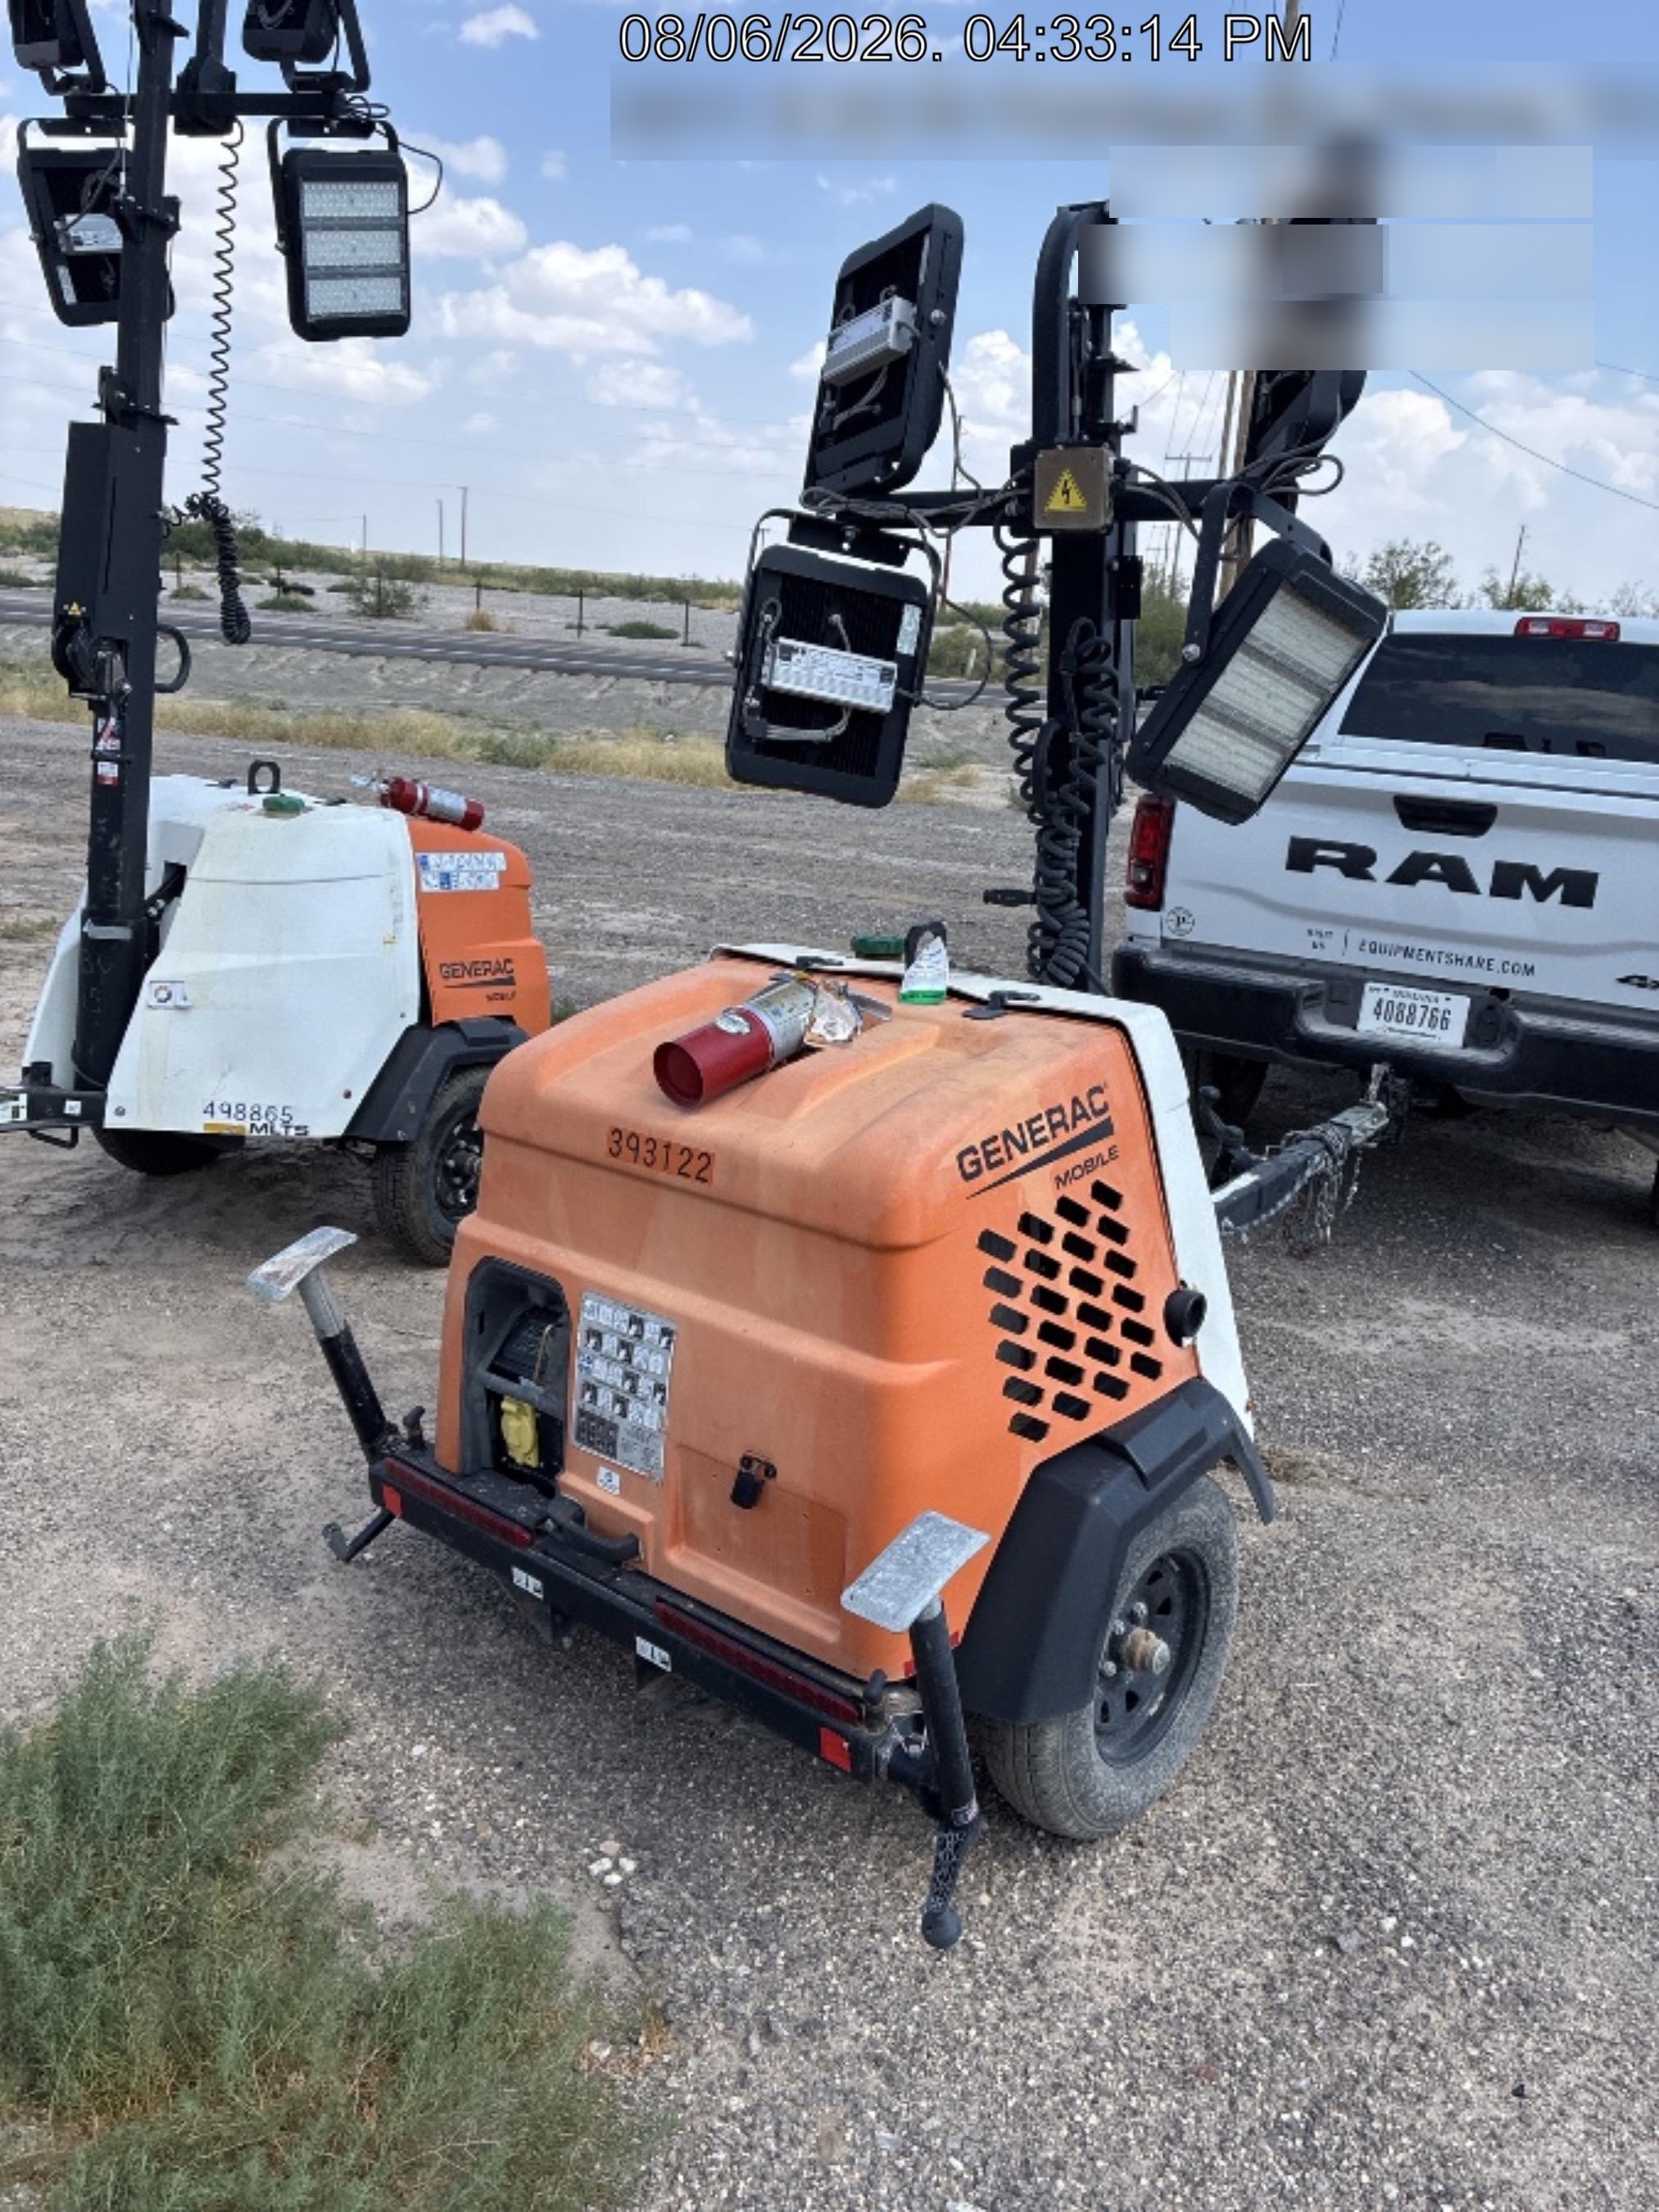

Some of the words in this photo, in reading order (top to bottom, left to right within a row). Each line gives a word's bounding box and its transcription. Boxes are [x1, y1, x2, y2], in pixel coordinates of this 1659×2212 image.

[1285, 836, 1599, 909] RAM
[440, 958, 514, 979] GENERAC
[1358, 938, 1535, 977] EQUIPMENTSHARE.COM
[1373, 997, 1452, 1031] 4088766
[203, 1100, 293, 1125] 498865
[957, 1085, 1109, 1182] GENERAC
[609, 1127, 711, 1182] 393122
[1054, 1145, 1119, 1190] MOBILE
